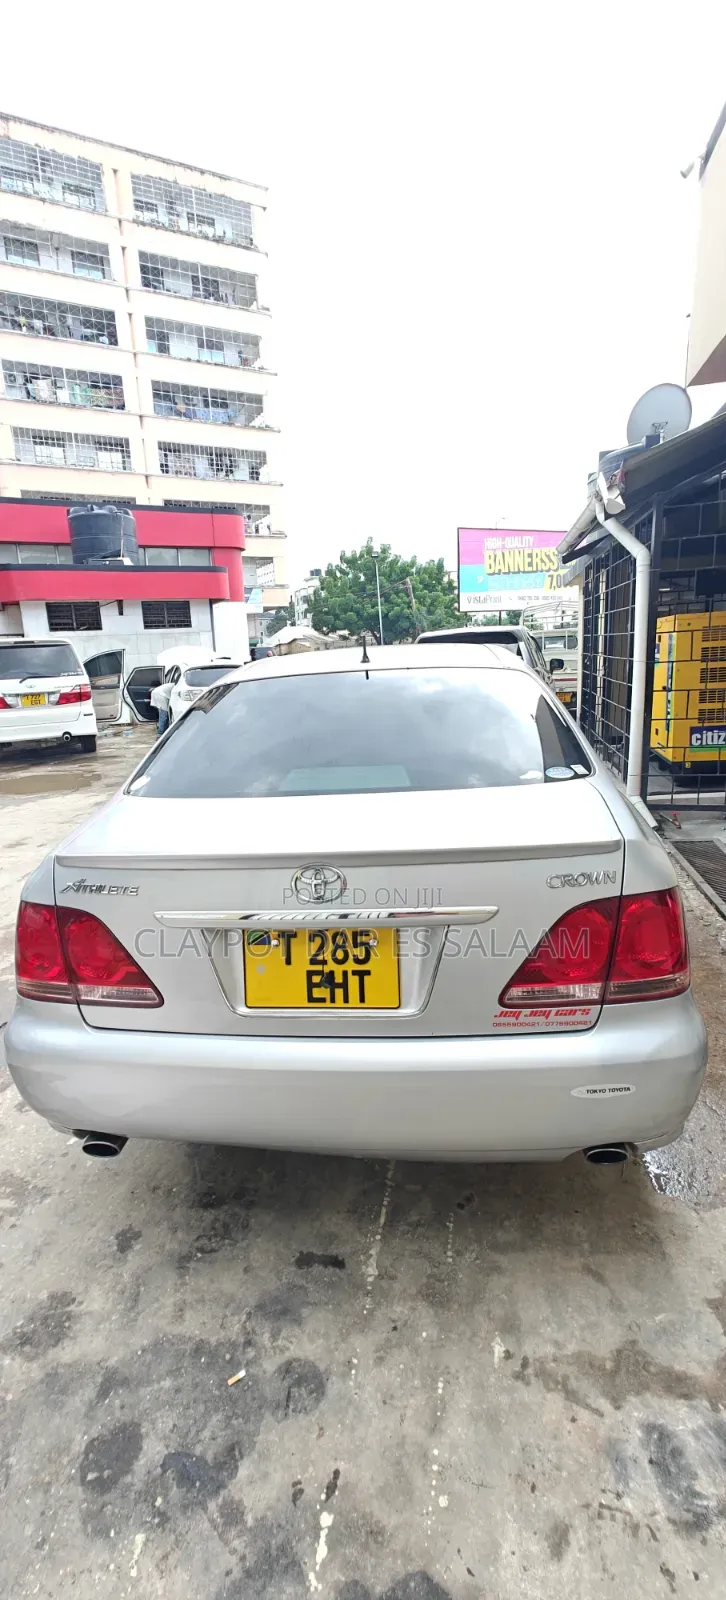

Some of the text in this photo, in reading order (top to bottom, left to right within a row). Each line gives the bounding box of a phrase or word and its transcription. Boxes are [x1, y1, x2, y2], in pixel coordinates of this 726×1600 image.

[485, 537, 533, 549] HIGH-QUALITY
[546, 870, 616, 888] CROWN
[278, 930, 372, 967] T 285
[305, 969, 372, 1004] EHT
[608, 1086, 631, 1094] TOYOTA
